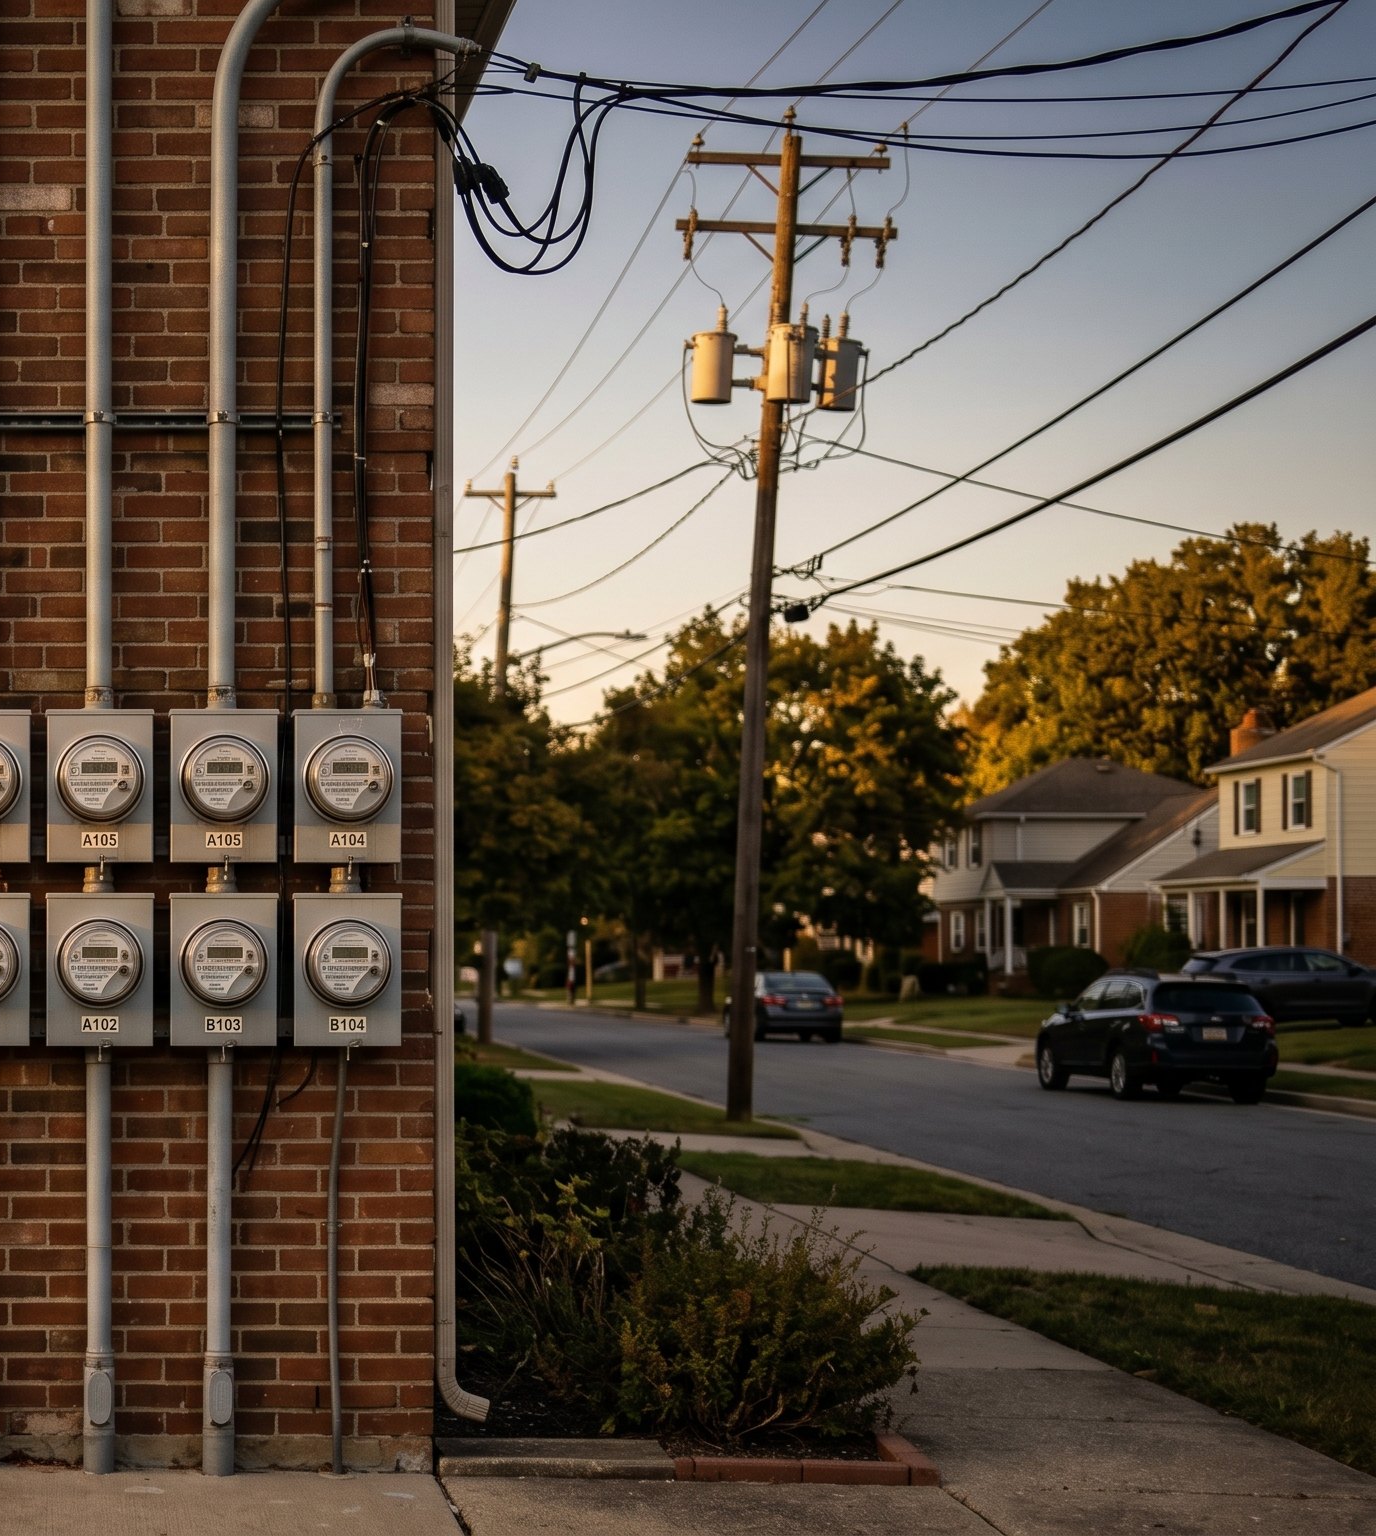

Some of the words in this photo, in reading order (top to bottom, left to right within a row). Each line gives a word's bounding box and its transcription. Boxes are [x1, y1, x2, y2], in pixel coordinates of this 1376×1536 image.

[83, 834, 117, 847] A105
[207, 834, 241, 847] A105
[331, 834, 365, 846] A104
[83, 1018, 117, 1031] A102
[207, 1018, 240, 1031] B103
[331, 1018, 364, 1031] B104
